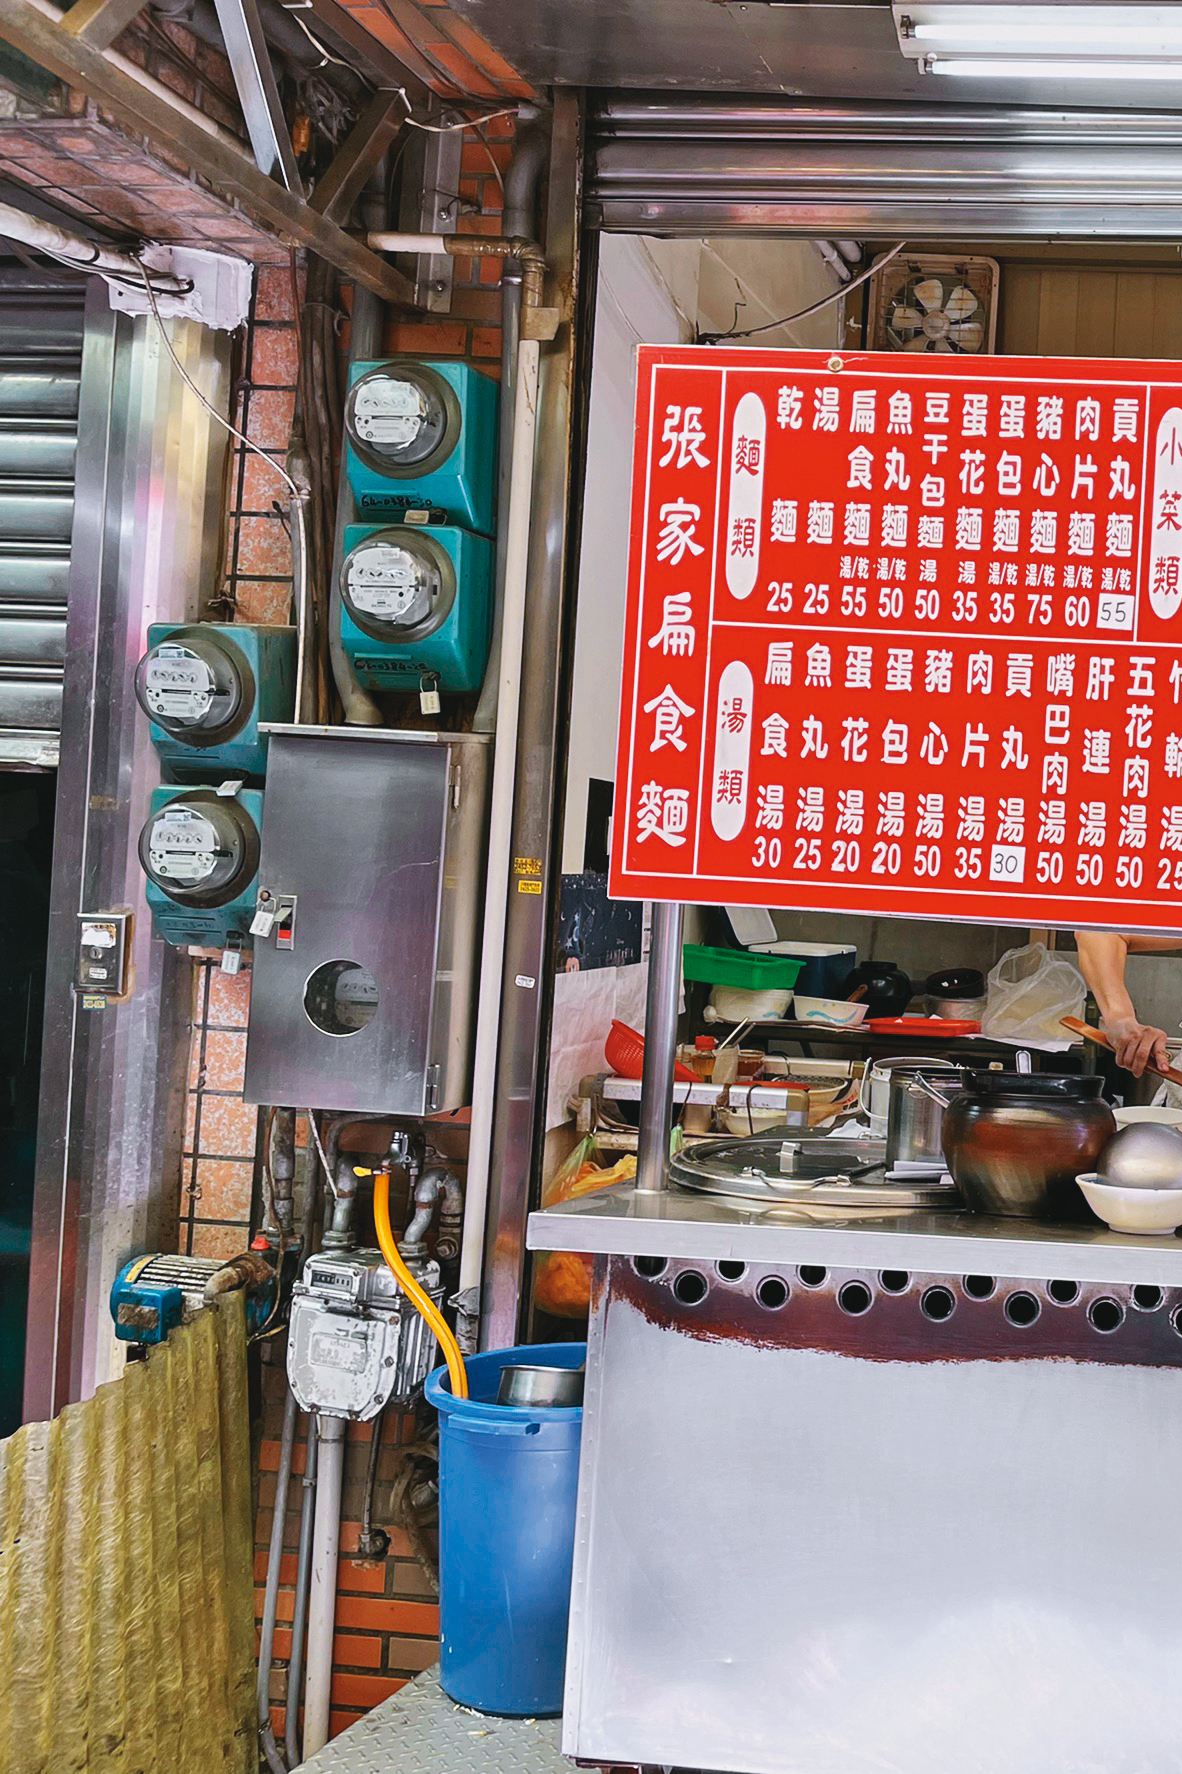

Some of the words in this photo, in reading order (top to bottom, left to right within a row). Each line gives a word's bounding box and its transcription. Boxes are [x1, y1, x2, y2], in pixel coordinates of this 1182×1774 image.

[730, 437, 761, 559] 麵類
[770, 385, 804, 543] 乾麵
[806, 387, 840, 545] 湯麵
[843, 389, 878, 546] 扁食麵
[880, 389, 913, 547] 魚丸麵
[917, 392, 951, 548] 豆干包麵
[955, 392, 989, 551] 蛋花麵
[992, 394, 1026, 553] 蛋包麵
[1030, 395, 1064, 554] 豬心麵
[1067, 397, 1100, 556] 肉片麵
[1104, 399, 1139, 557] 貢丸麵
[636, 405, 710, 848] 張家扁食麵
[768, 582, 792, 613] 25
[803, 584, 829, 614] 25
[841, 585, 866, 616] 55
[878, 588, 903, 618] 50
[914, 589, 940, 620] 50
[952, 591, 978, 622] 35
[989, 592, 1015, 624] 35
[1027, 594, 1053, 624] 75
[1064, 596, 1090, 627] 60
[1100, 601, 1127, 623] 55
[841, 556, 869, 579] 湯/乾
[876, 558, 906, 581] 湯/乾
[919, 560, 937, 582] 湯
[959, 561, 976, 584] 湯
[988, 562, 1018, 585] 湯/乾
[1026, 564, 1055, 587] 湯/乾
[1064, 565, 1094, 588] 湯/乾
[1102, 567, 1131, 590] 湯/乾
[717, 697, 747, 805] 湯類
[755, 641, 794, 831] 扁食湯
[796, 642, 832, 833] 魚丸湯
[835, 645, 872, 835] 蛋花湯
[876, 648, 913, 836] 蛋包湯
[916, 648, 951, 839] 豬心湯
[956, 650, 992, 842] 肉片湯
[997, 653, 1033, 844] 貢丸湯
[1037, 653, 1075, 845] 嘴巴肉湯
[1078, 656, 1115, 847] 肝連湯
[1119, 656, 1156, 849] 五花肉湯
[752, 836, 781, 868] 30
[793, 839, 821, 870] 25
[831, 841, 859, 872] 20
[872, 842, 900, 874] 20
[914, 844, 940, 876] 50
[954, 847, 982, 879] 35
[994, 853, 1018, 874] 30
[1037, 852, 1063, 884] 50
[1076, 854, 1103, 886] 50
[1116, 856, 1143, 888] 50
